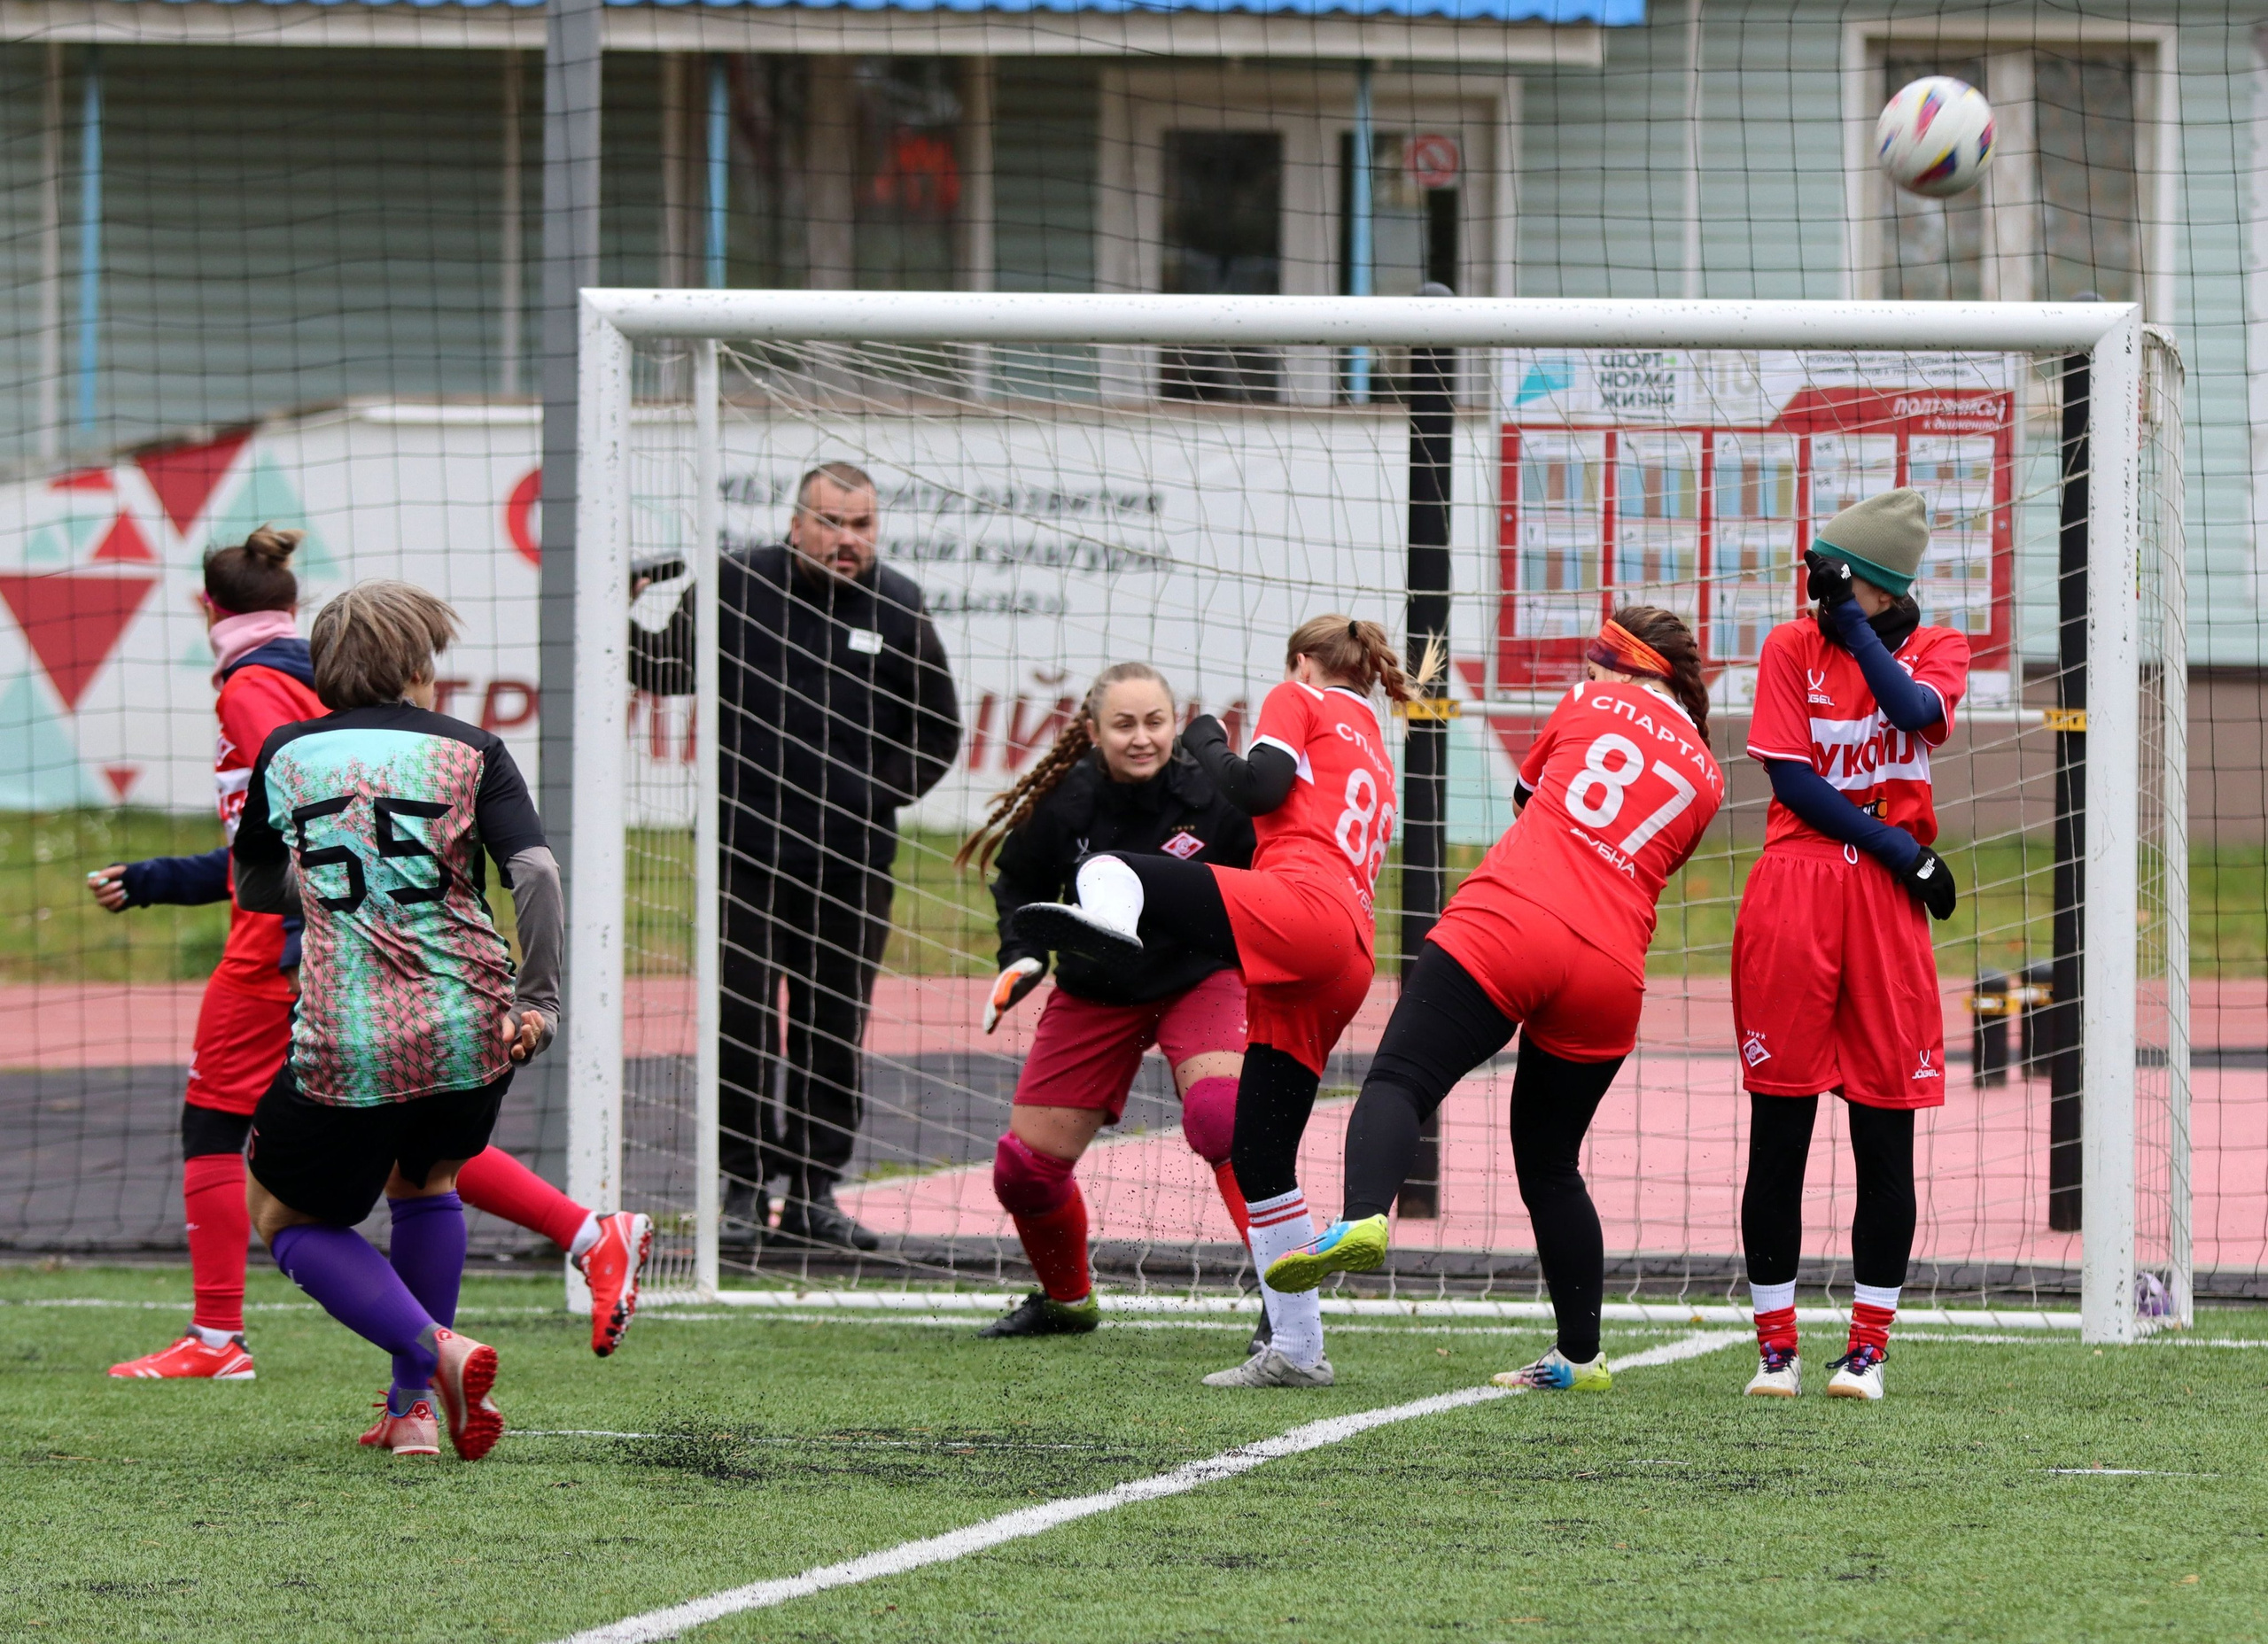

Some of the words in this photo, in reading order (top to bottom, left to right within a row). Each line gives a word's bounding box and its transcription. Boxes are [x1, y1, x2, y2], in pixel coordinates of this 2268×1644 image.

[1600, 352, 1664, 368] СПОРТ
[1600, 371, 1674, 387] НОРМА
[1600, 392, 1674, 409] ЖИЗНИ
[1591, 695, 1719, 790] СПАРТАК
[1335, 768, 1396, 896] 88
[1565, 733, 1697, 857] 87
[291, 795, 454, 914] 55
